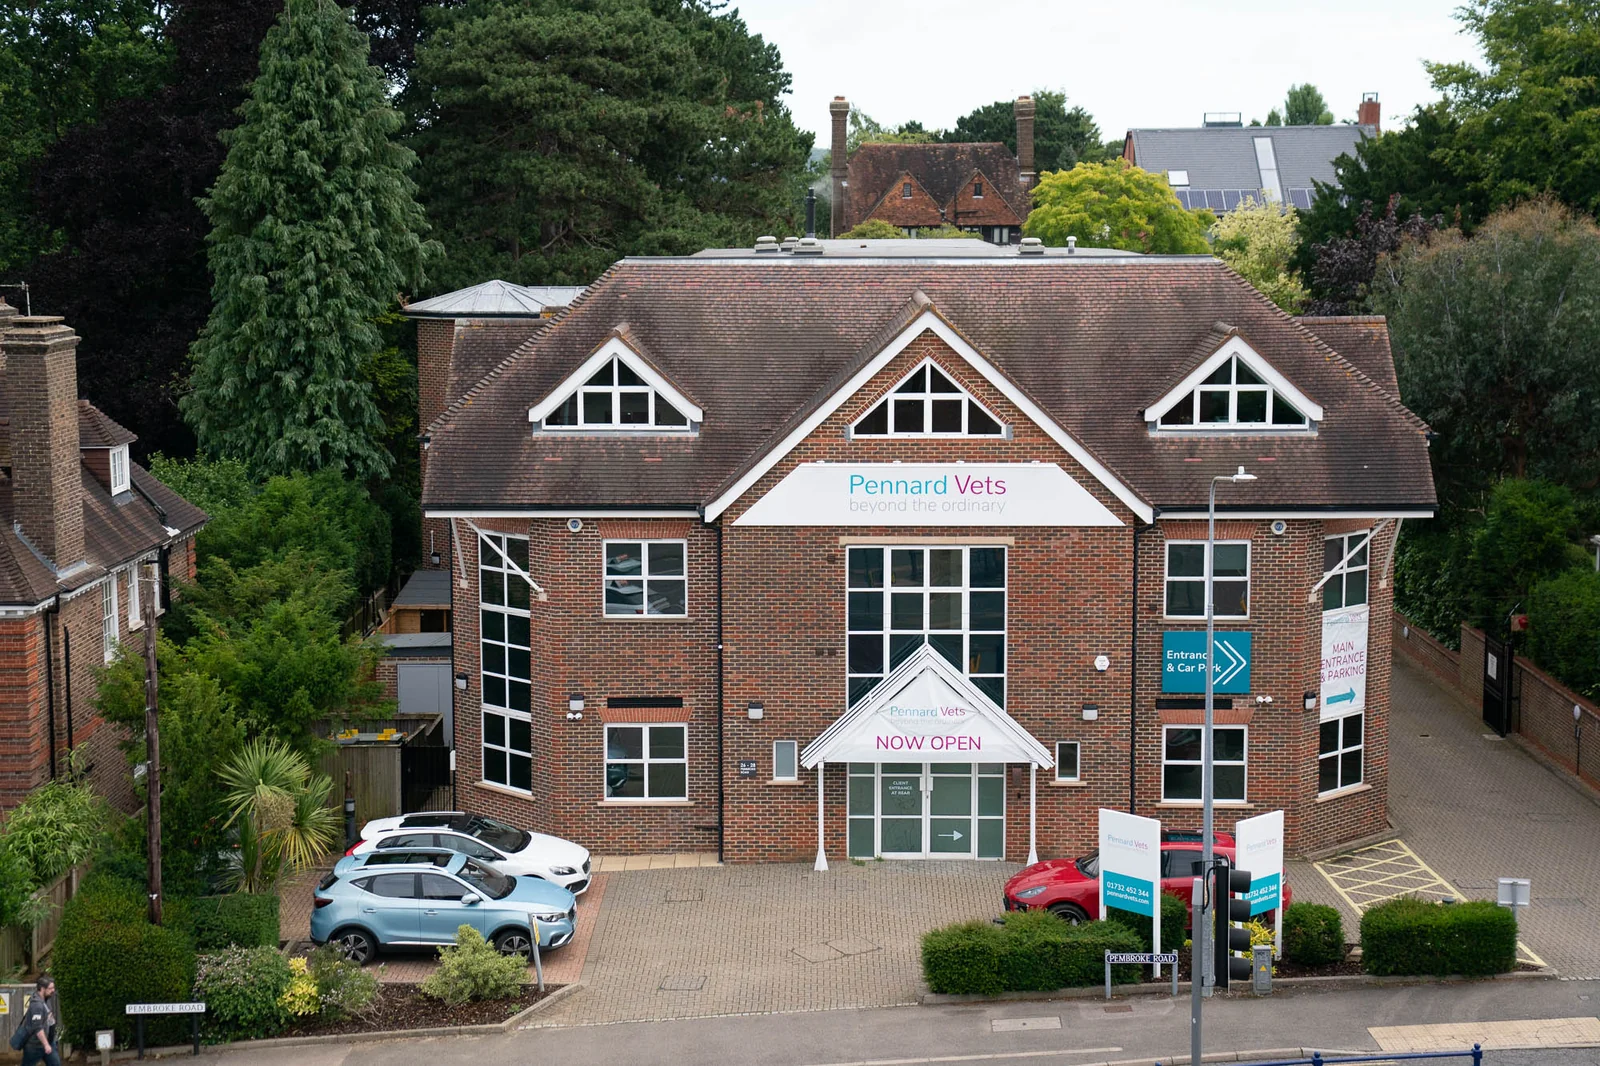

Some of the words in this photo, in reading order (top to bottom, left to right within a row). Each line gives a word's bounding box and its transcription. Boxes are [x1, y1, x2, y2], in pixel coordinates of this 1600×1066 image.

[849, 474, 948, 495] Pennard
[954, 474, 1007, 495] Vets
[849, 498, 907, 514] beyond
[912, 498, 937, 512] the
[941, 498, 1006, 514] ordinary
[1332, 641, 1354, 654] MAIN
[1166, 650, 1212, 660] Entranc
[1320, 651, 1365, 670] ENTRANCE
[1166, 663, 1175, 672] &
[1177, 664, 1195, 672] Car
[1320, 672, 1326, 683] &
[1327, 664, 1365, 681] PARKING
[890, 706, 938, 717] Pennard
[940, 706, 966, 717] Vets
[876, 736, 924, 750] NOW
[930, 736, 981, 750] OPEN
[1107, 834, 1133, 846] Pennard
[1134, 840, 1148, 850] Vets
[1106, 881, 1125, 891] 01732
[1126, 886, 1137, 894] 452
[1138, 888, 1149, 897] 344
[1106, 890, 1149, 904] pennardvets.com
[128, 1005, 177, 1013] PEMBROKE
[178, 1003, 204, 1012] ROAD
